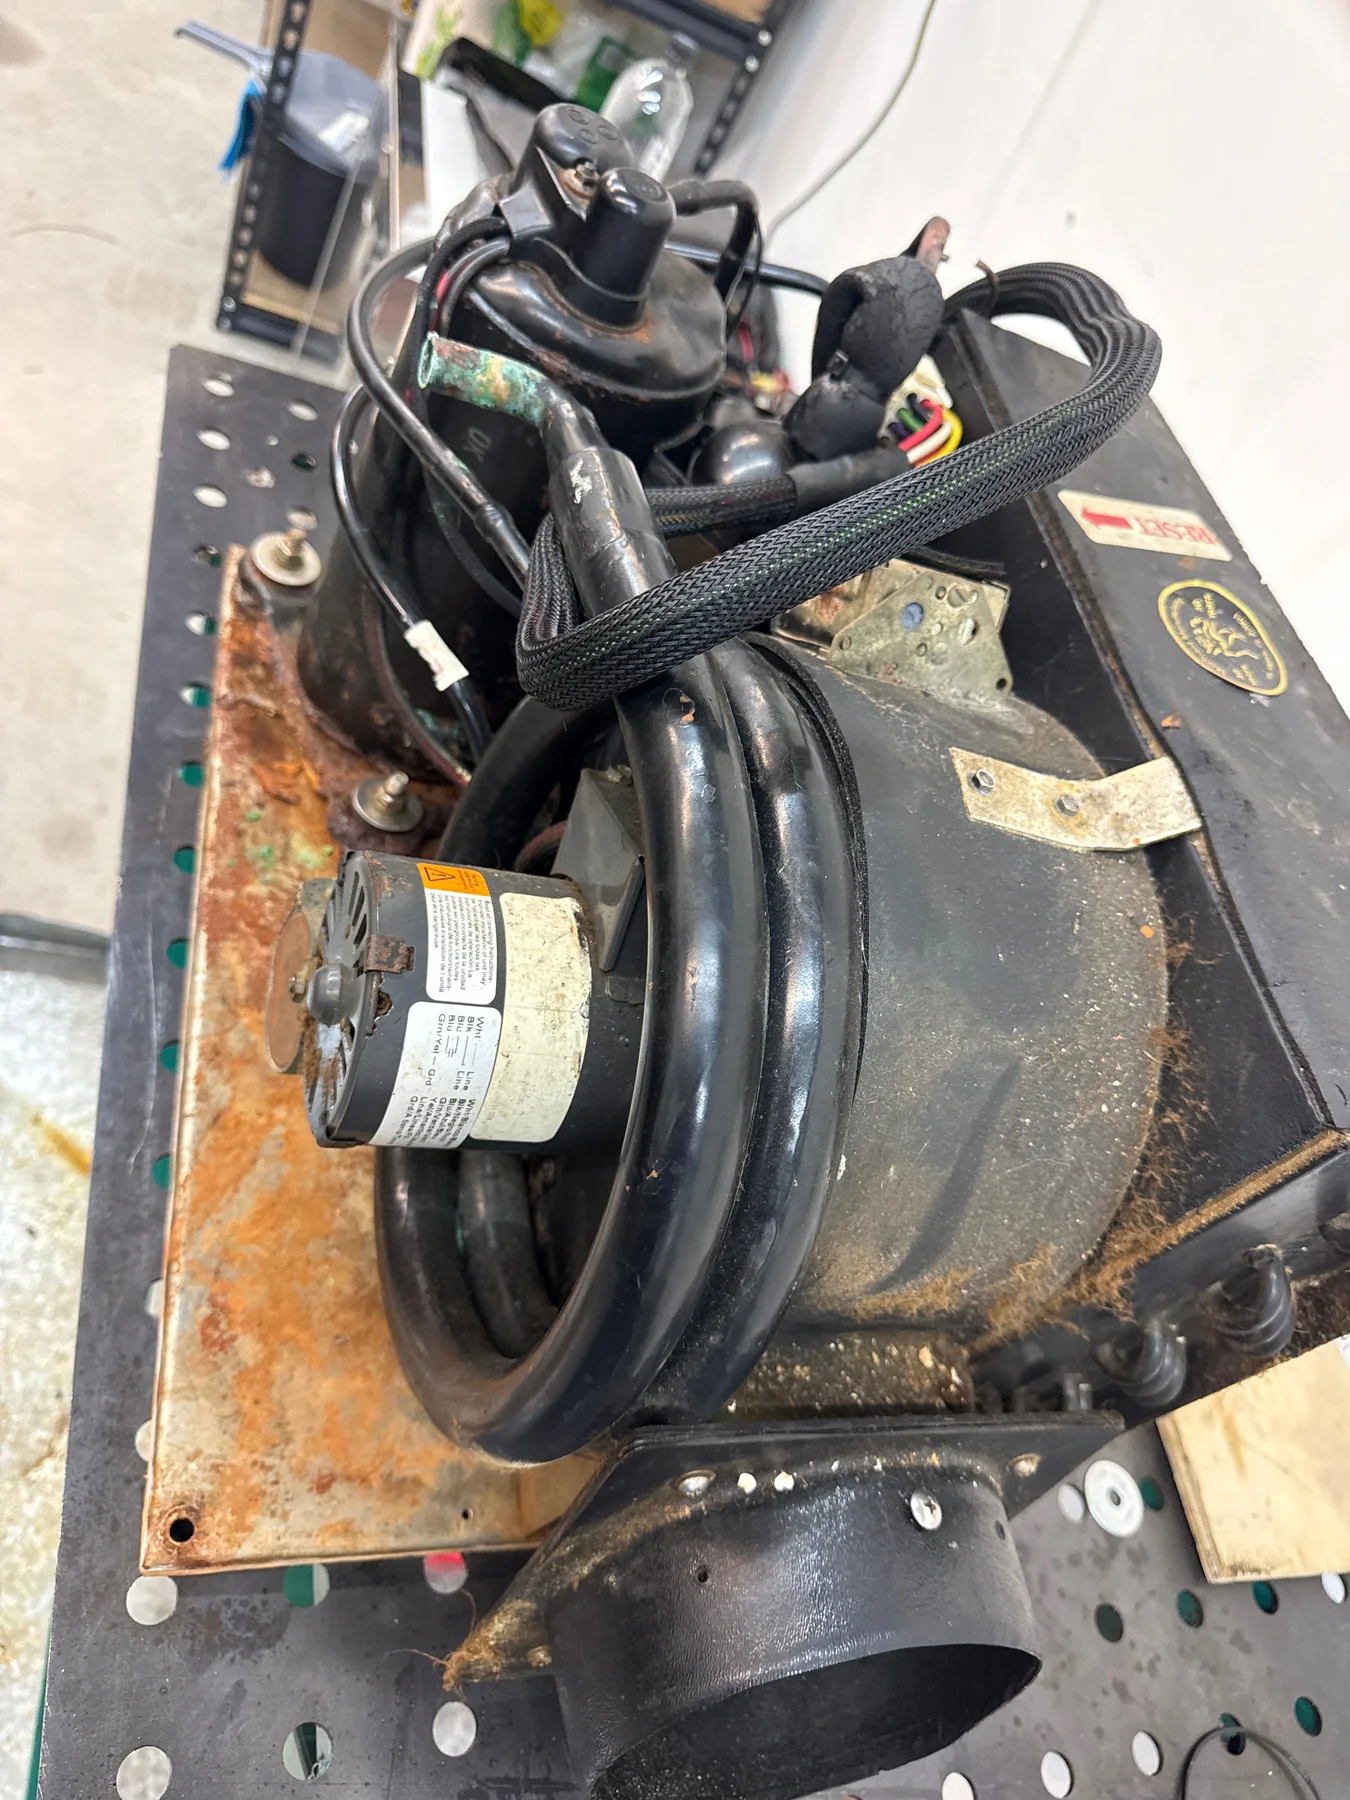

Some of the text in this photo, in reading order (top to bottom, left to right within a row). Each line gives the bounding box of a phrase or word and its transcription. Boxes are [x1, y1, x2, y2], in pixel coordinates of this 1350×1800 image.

[1134, 516, 1217, 545] RESET
[441, 963, 446, 971] de
[446, 1014, 456, 1032] Blu
[425, 1013, 446, 1086] Grn/Yel Grd
[453, 1016, 475, 1091] Blk Line
[463, 1016, 485, 1091] Wht Line
